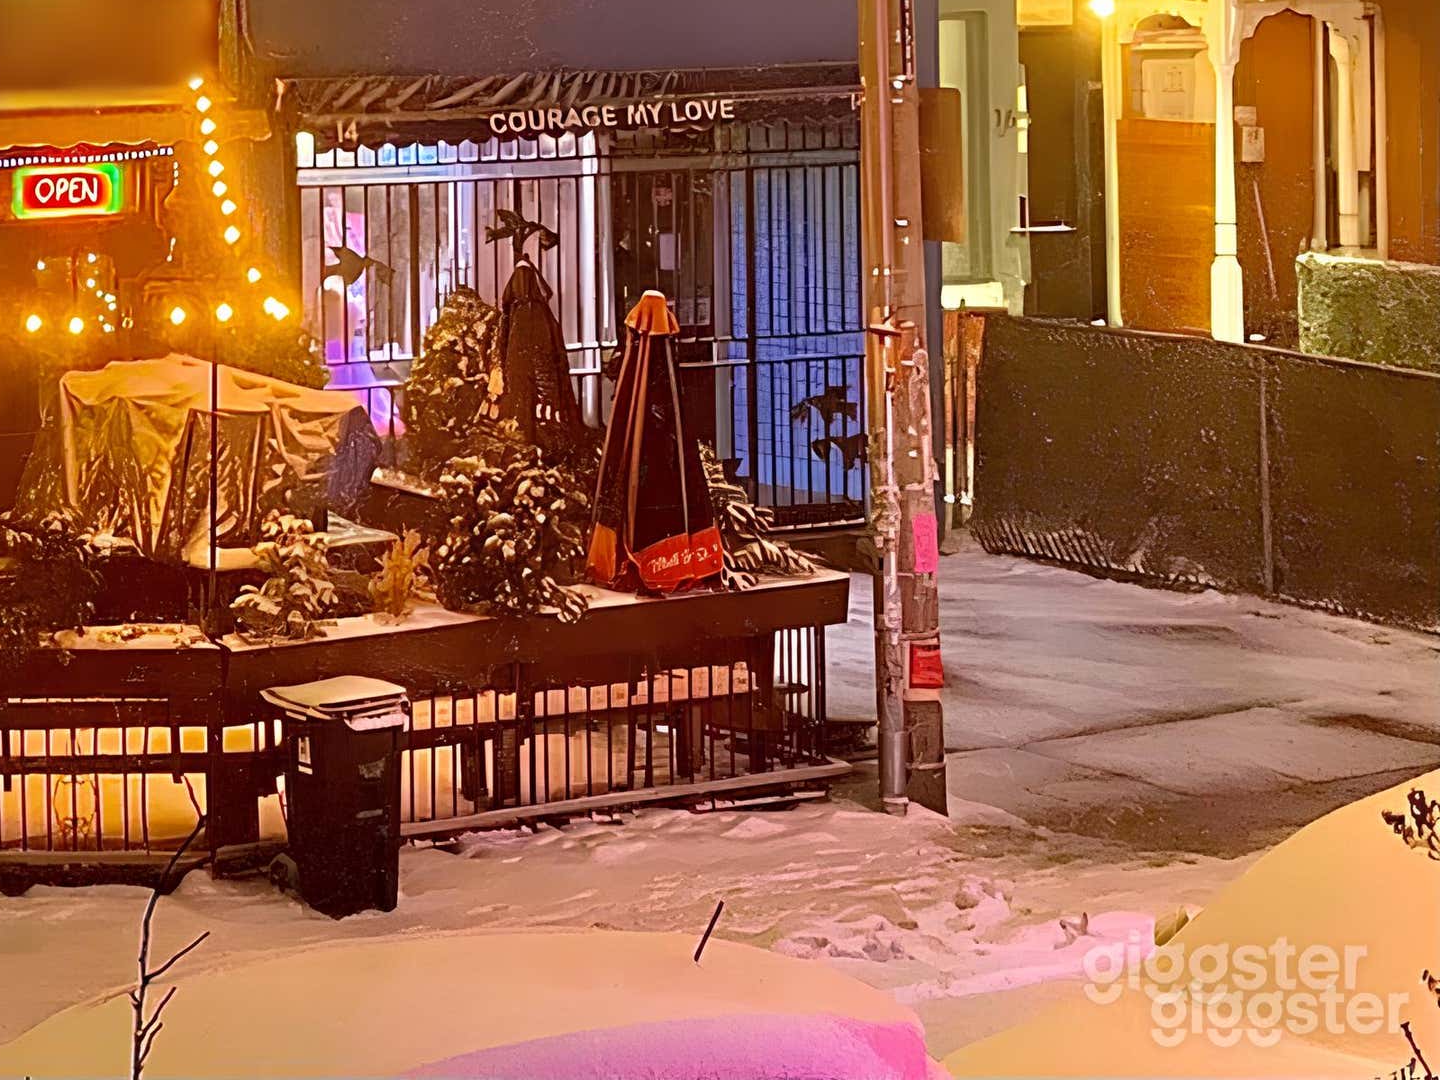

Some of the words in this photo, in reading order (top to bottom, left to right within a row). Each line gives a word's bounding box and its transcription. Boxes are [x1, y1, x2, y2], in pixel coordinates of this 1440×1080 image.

[489, 105, 618, 134] COURAGE
[627, 100, 664, 127] MY
[671, 99, 735, 123] LOVE
[34, 176, 98, 204] OPEN
